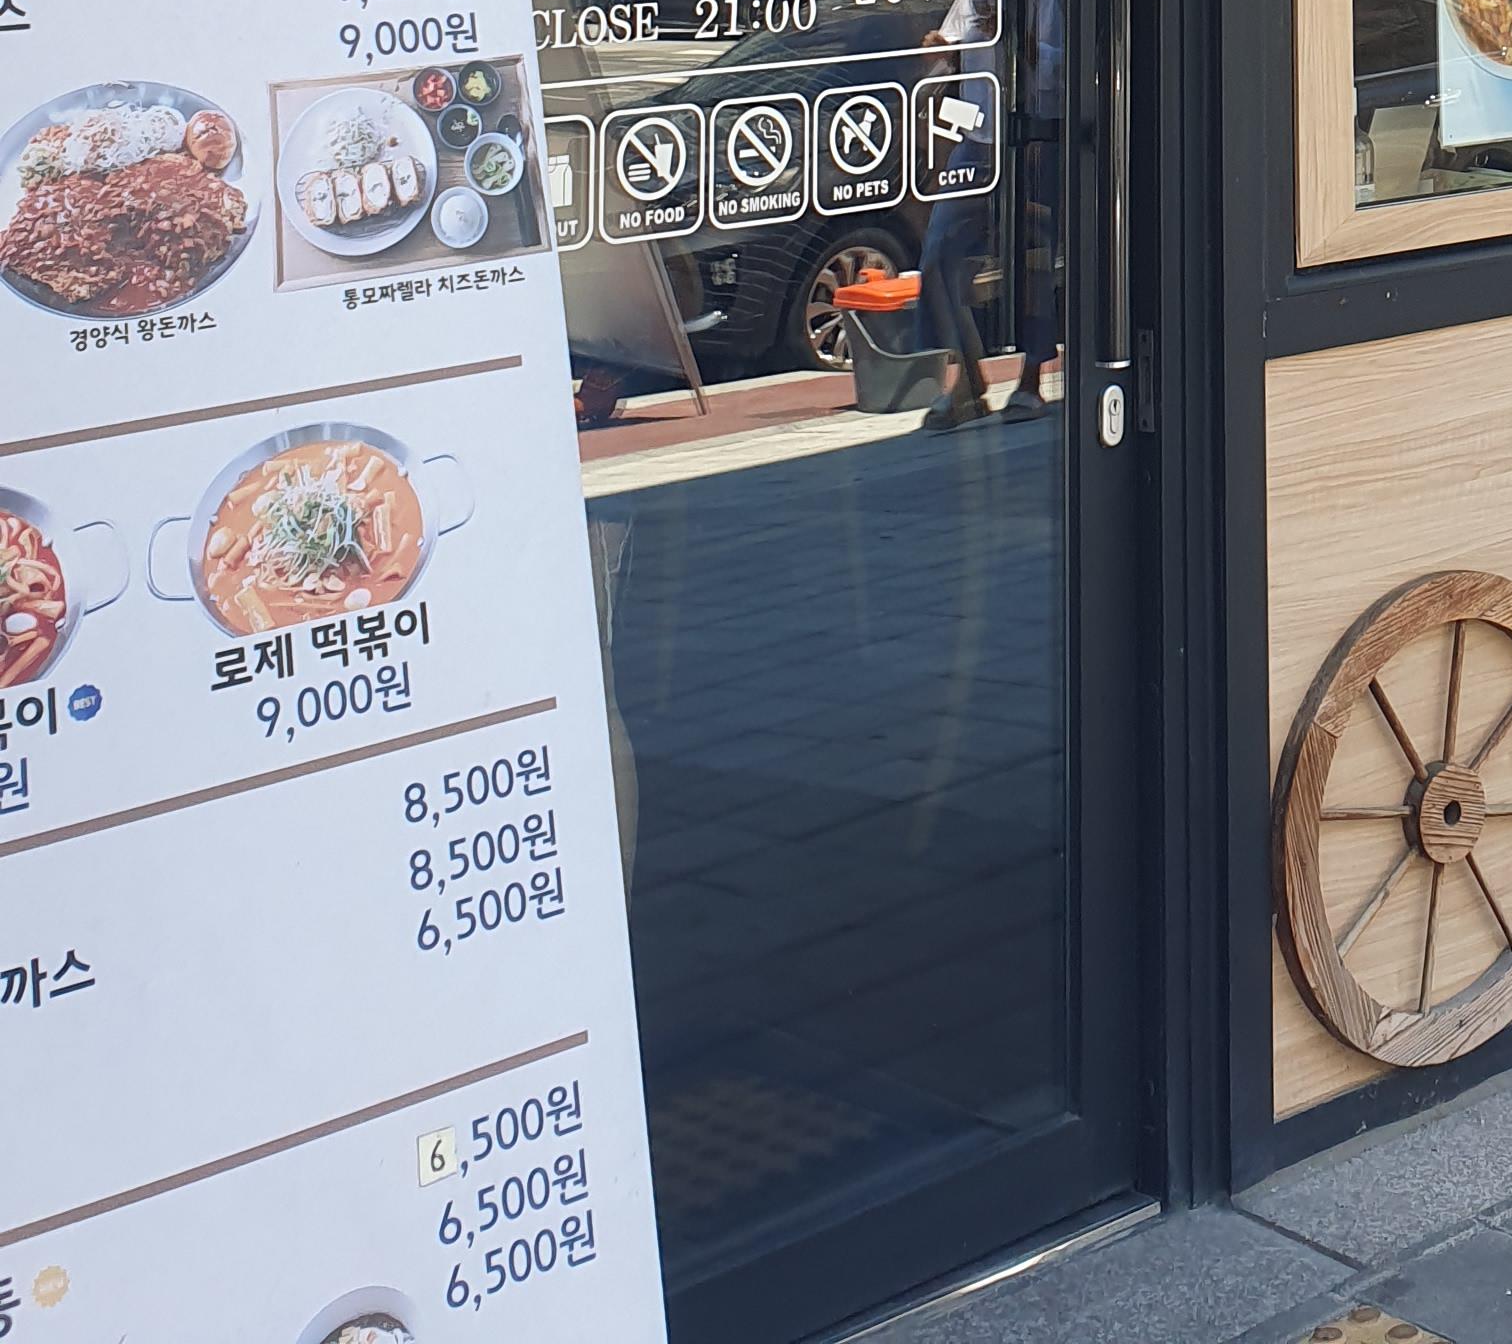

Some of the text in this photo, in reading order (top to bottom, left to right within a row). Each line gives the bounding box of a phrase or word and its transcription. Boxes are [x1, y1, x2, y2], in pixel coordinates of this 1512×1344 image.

[339, 13, 480, 65] 9,000원
[533, 3, 660, 49] CLOSE
[718, 191, 801, 216] NO SMOKING
[832, 179, 889, 201] NO PETS
[937, 167, 976, 186] CCTV
[553, 220, 578, 239] UT
[619, 206, 685, 229] NO FOOD
[341, 266, 526, 310] 통모짜렐라 치즈돈까스
[69, 312, 218, 353] 경양식 왕돈까스
[210, 603, 431, 692] 로제 떡볶이
[0, 687, 57, 751] 이
[255, 663, 412, 744] 9,000원
[403, 745, 553, 827] 8,500원
[409, 810, 559, 894] 8,500원
[416, 868, 566, 956] 6,500원
[428, 1080, 583, 1178] 6,500원
[438, 1149, 590, 1248] 6,500원
[445, 1210, 597, 1312] 6,500원
